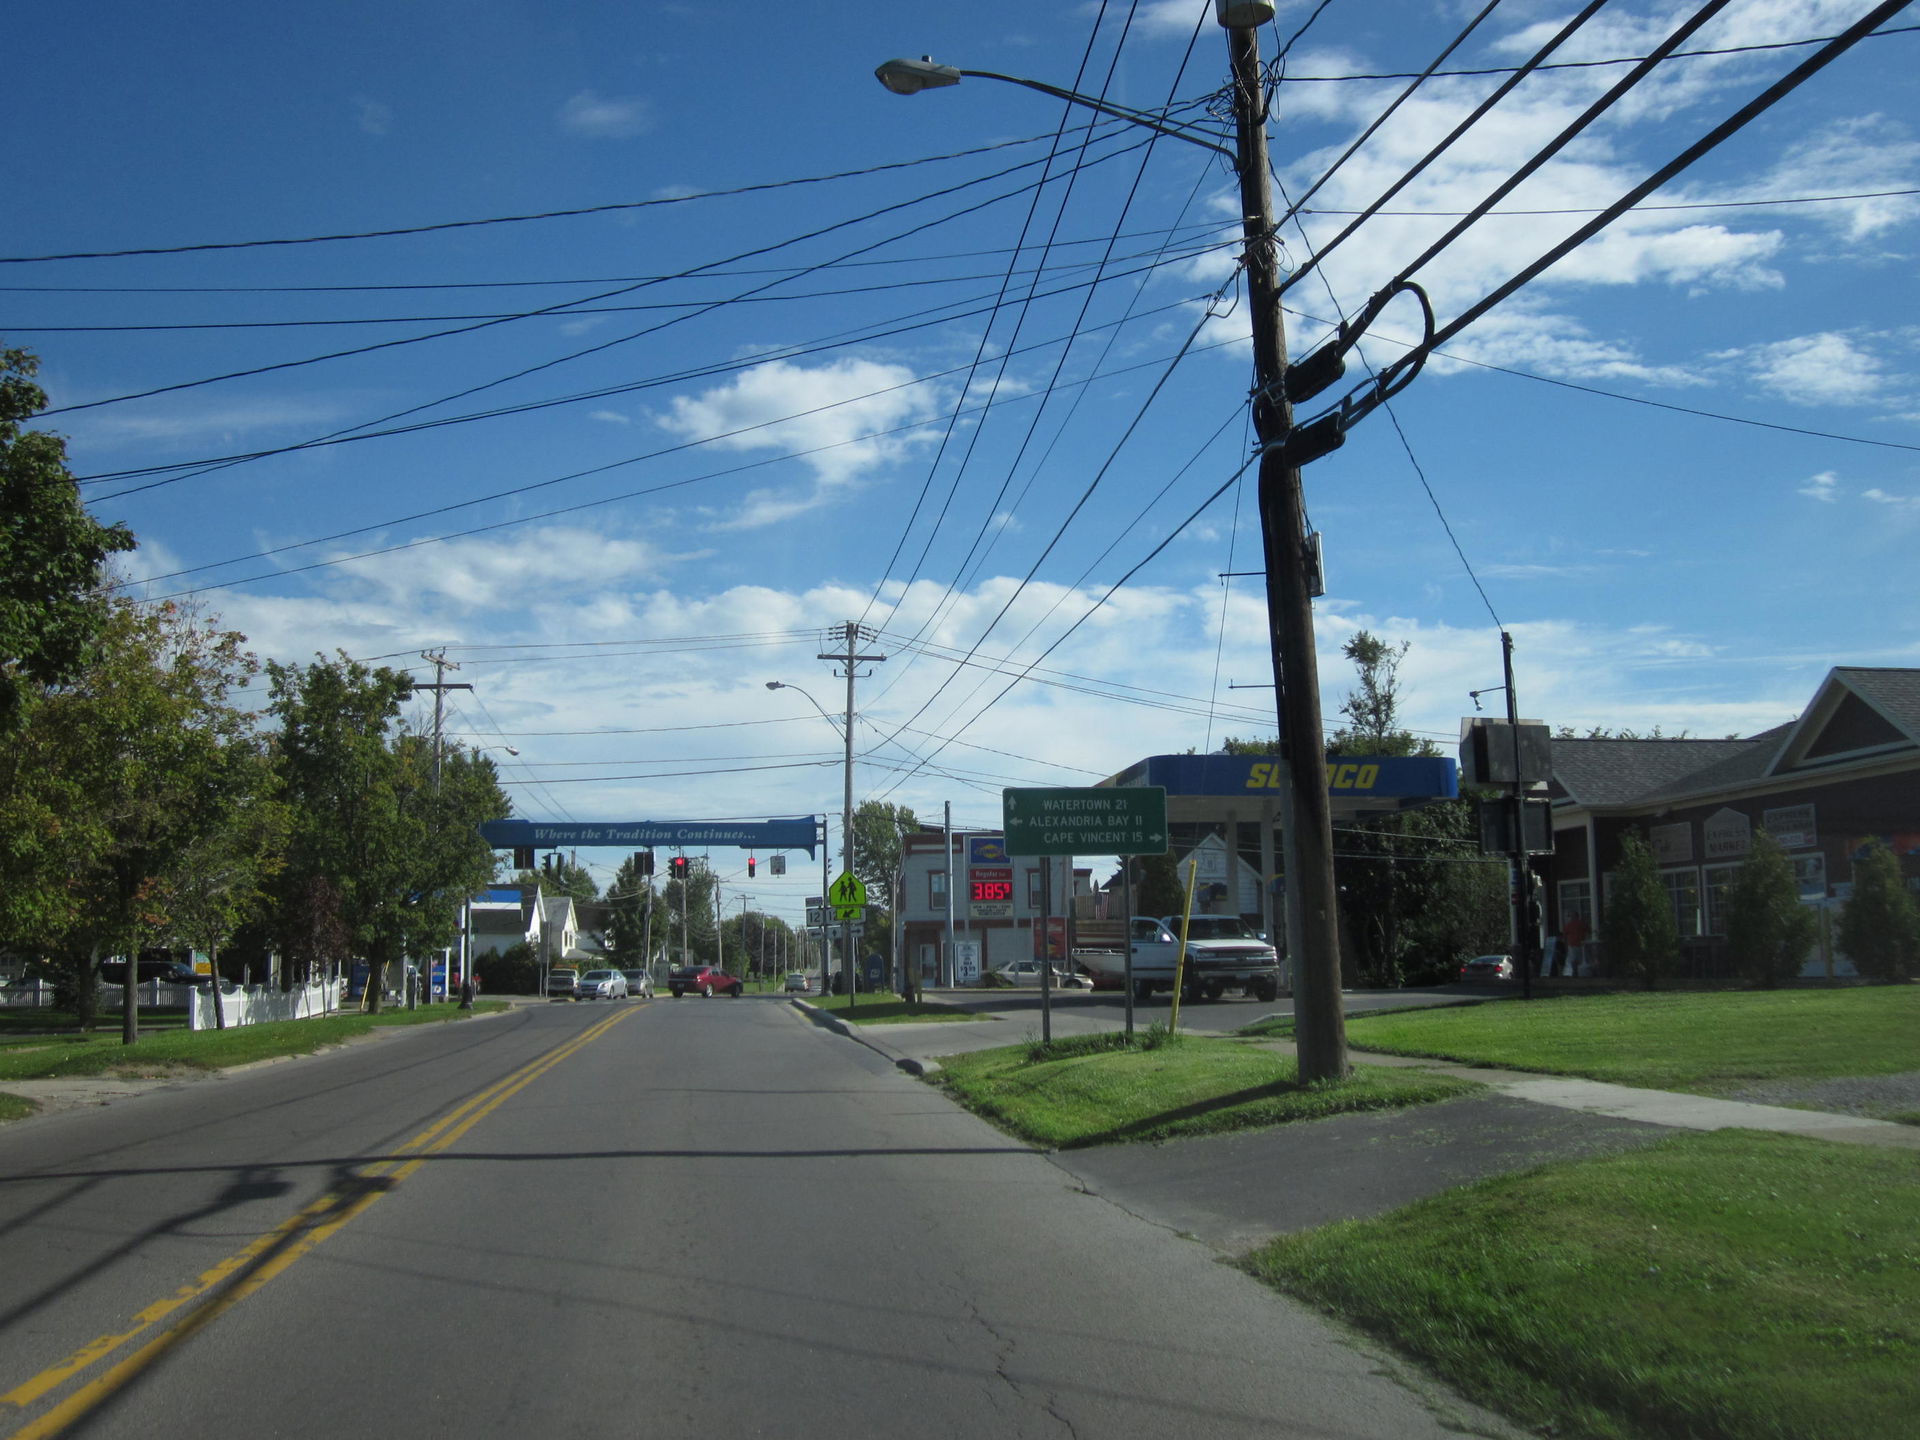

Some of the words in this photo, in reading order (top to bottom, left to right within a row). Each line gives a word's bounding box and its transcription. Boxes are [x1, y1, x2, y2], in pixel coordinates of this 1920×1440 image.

[1246, 763, 1379, 788] SUCO
[1043, 799, 1111, 810] WATERTOWN
[1116, 799, 1128, 809] 21
[1029, 816, 1103, 827] ALEXANDRIA
[1108, 816, 1130, 826] BAY
[1135, 815, 1142, 826] 11
[534, 828, 577, 839] Where
[581, 828, 601, 839] the
[607, 828, 671, 839] Tradition
[1044, 832, 1074, 843] CAPE
[1080, 832, 1127, 843] VINCENT
[1132, 832, 1143, 842] 15
[810, 911, 820, 922] 12
